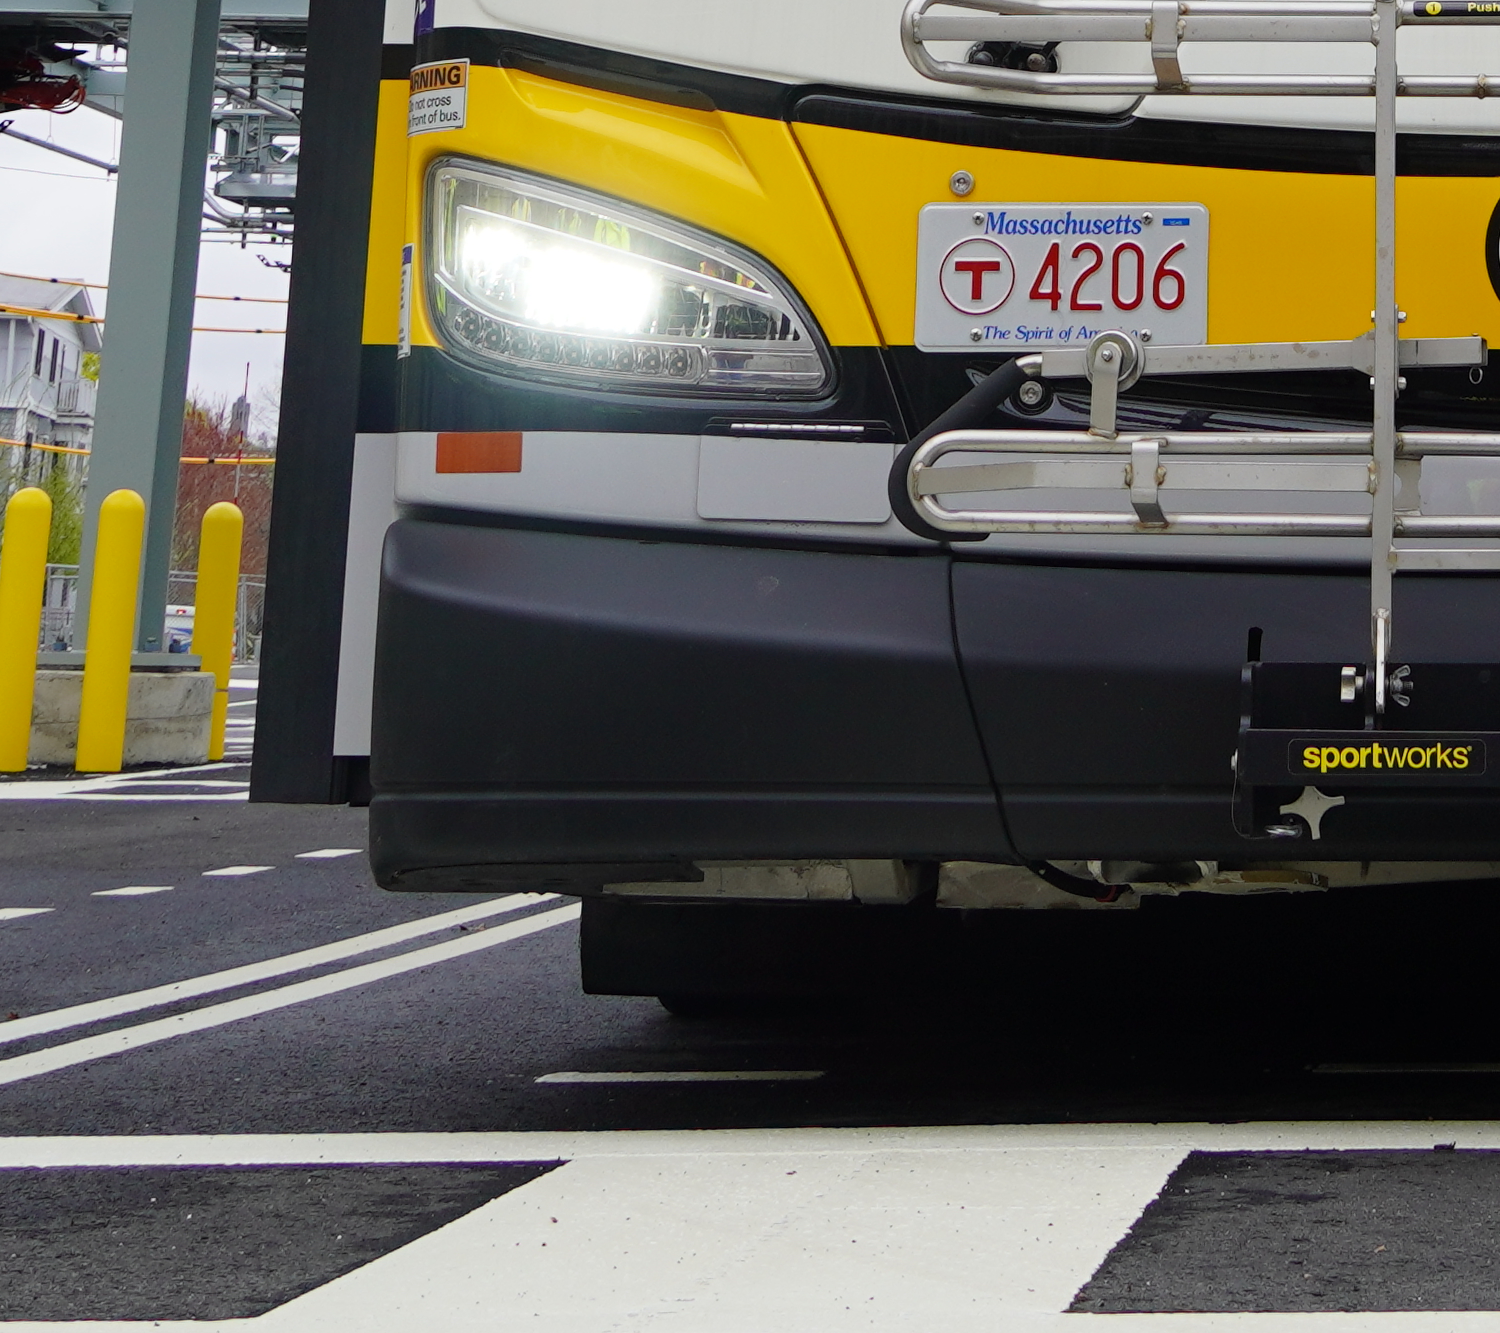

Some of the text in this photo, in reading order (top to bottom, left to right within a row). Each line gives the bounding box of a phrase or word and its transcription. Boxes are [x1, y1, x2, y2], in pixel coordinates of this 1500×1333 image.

[1467, 2, 1500, 13] Push
[415, 97, 426, 110] not
[426, 95, 452, 109] cross
[428, 110, 438, 124] of
[440, 109, 461, 122] bus.
[985, 210, 1143, 238] Massachusetts
[955, 242, 1187, 313] T 4206
[984, 325, 1011, 340] The
[1015, 325, 1054, 342] Spirit
[1058, 326, 1074, 343] of
[1302, 742, 1470, 773] sportworks
